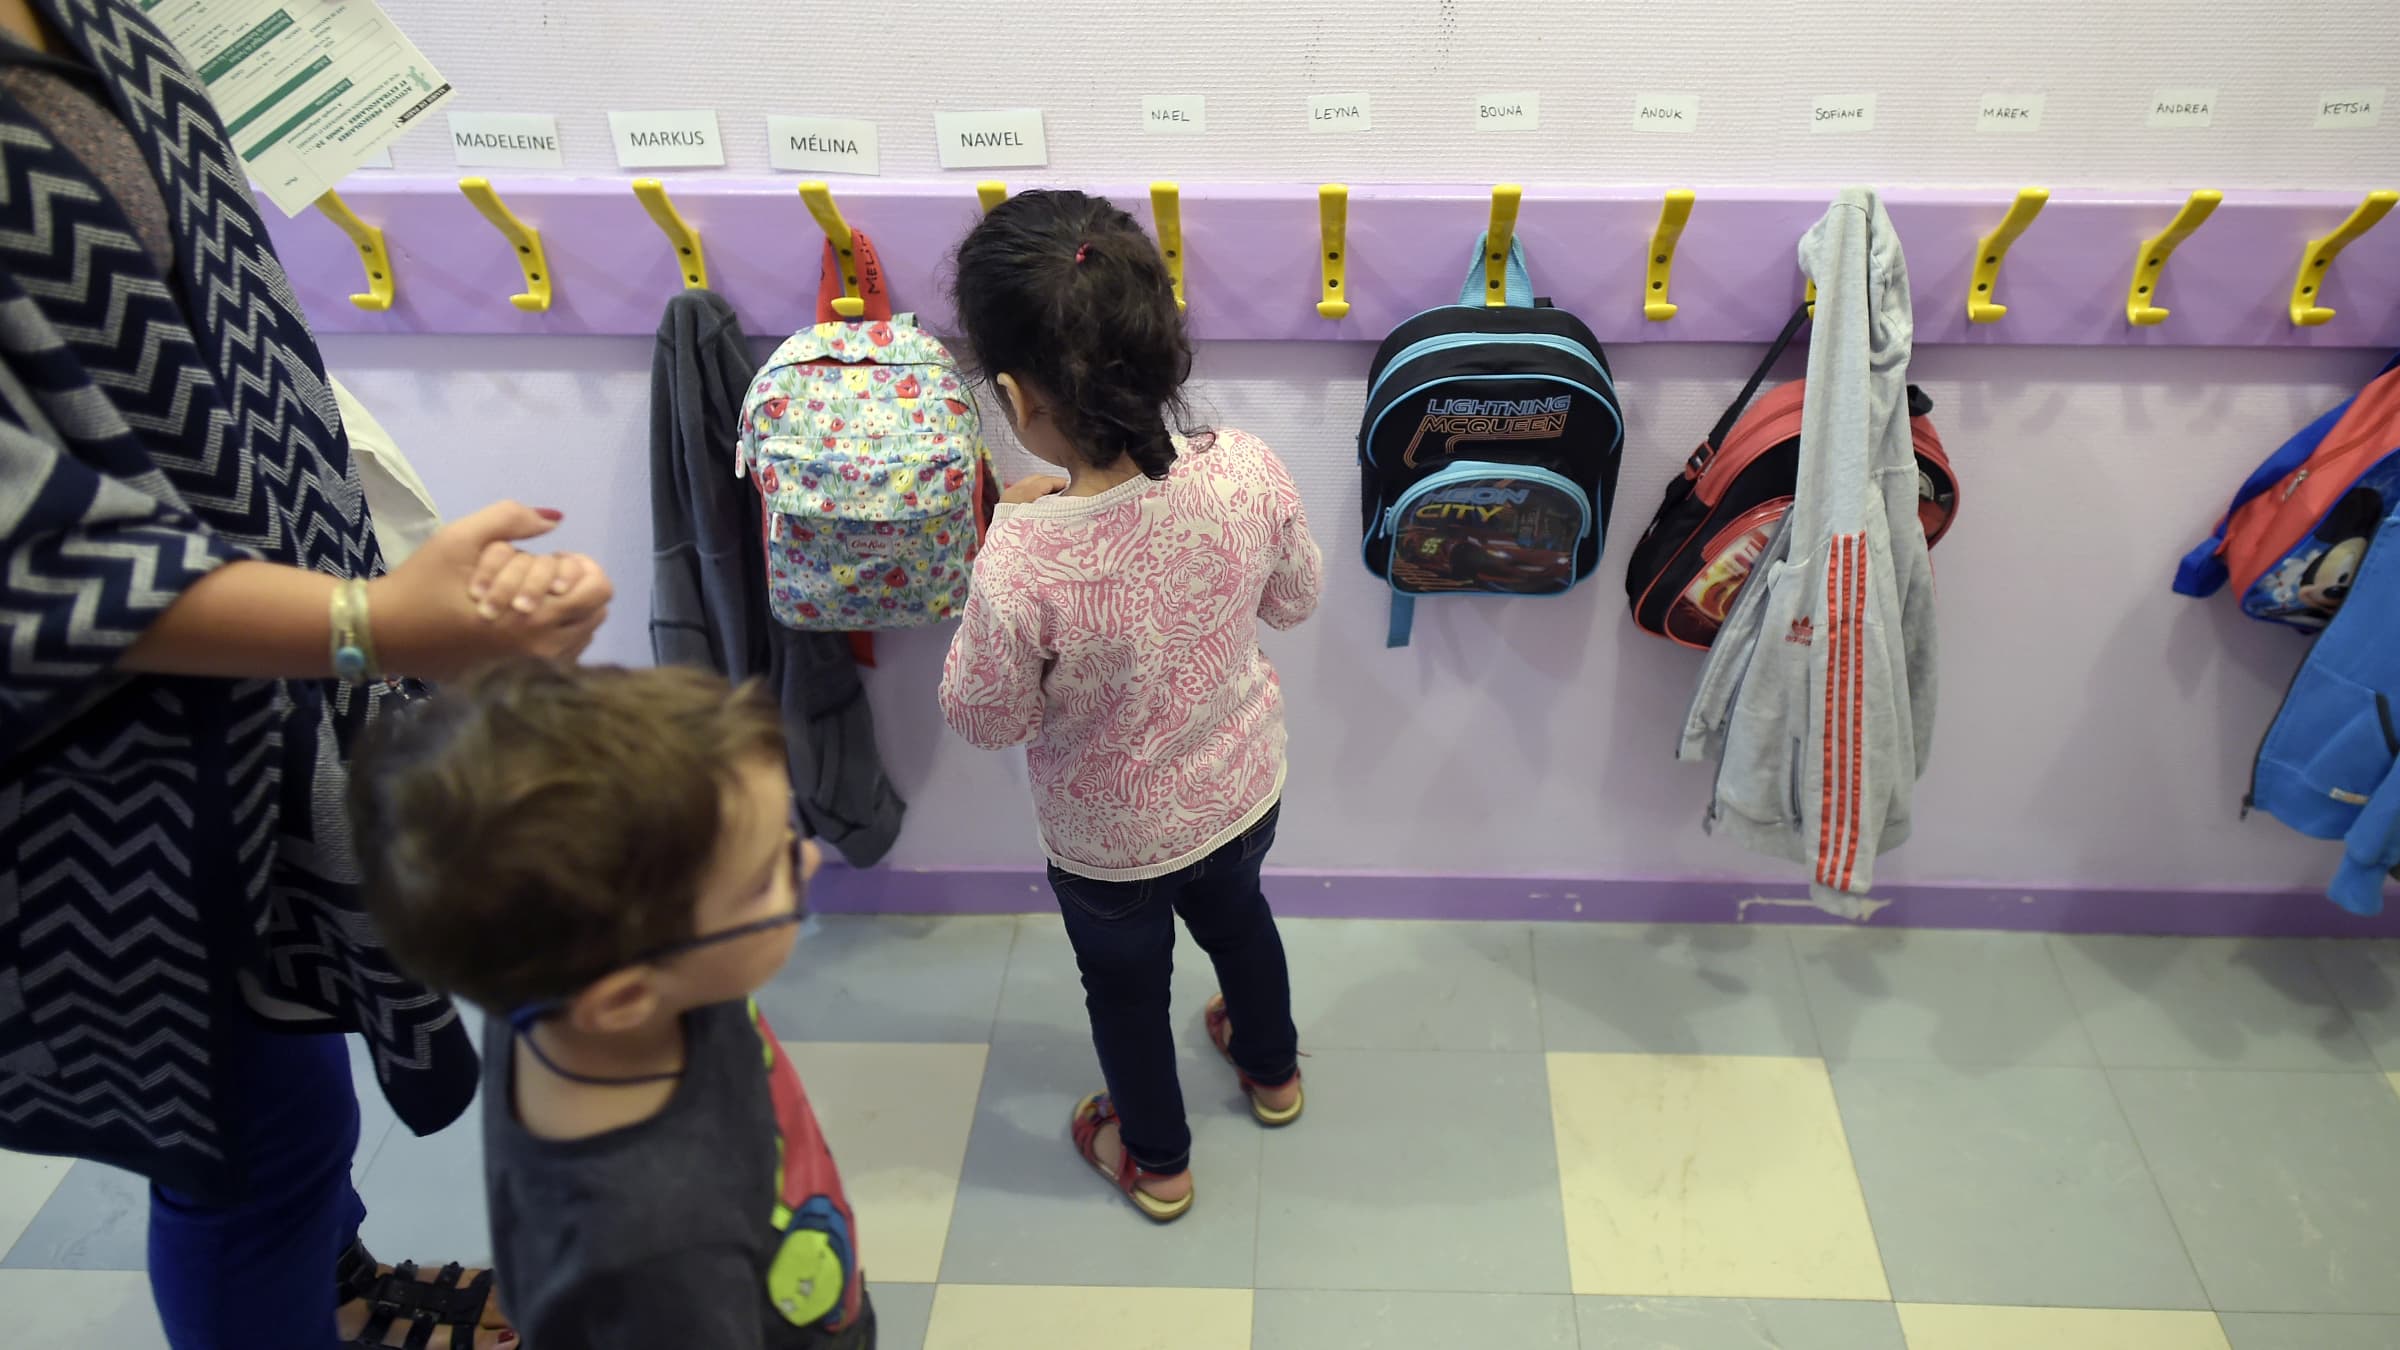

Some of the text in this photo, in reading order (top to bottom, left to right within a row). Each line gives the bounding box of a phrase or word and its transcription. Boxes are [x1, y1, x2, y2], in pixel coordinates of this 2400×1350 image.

[1151, 110, 1191, 122] NAEL
[1314, 106, 1360, 120] LEYNA
[1480, 105, 1523, 119] BOUNA
[1640, 107, 1683, 120] ANOUK
[1983, 107, 2030, 119] MAREK
[2156, 102, 2210, 114] ANDREA
[455, 132, 555, 151] MADELEINE
[630, 130, 705, 147] MARKUS
[790, 134, 858, 155] MÉLINA
[960, 131, 1023, 148] NAWEL
[1427, 395, 1571, 415] LIGHTNING
[1421, 413, 1567, 434] MCQUEEN
[1415, 503, 1503, 522] CITY
